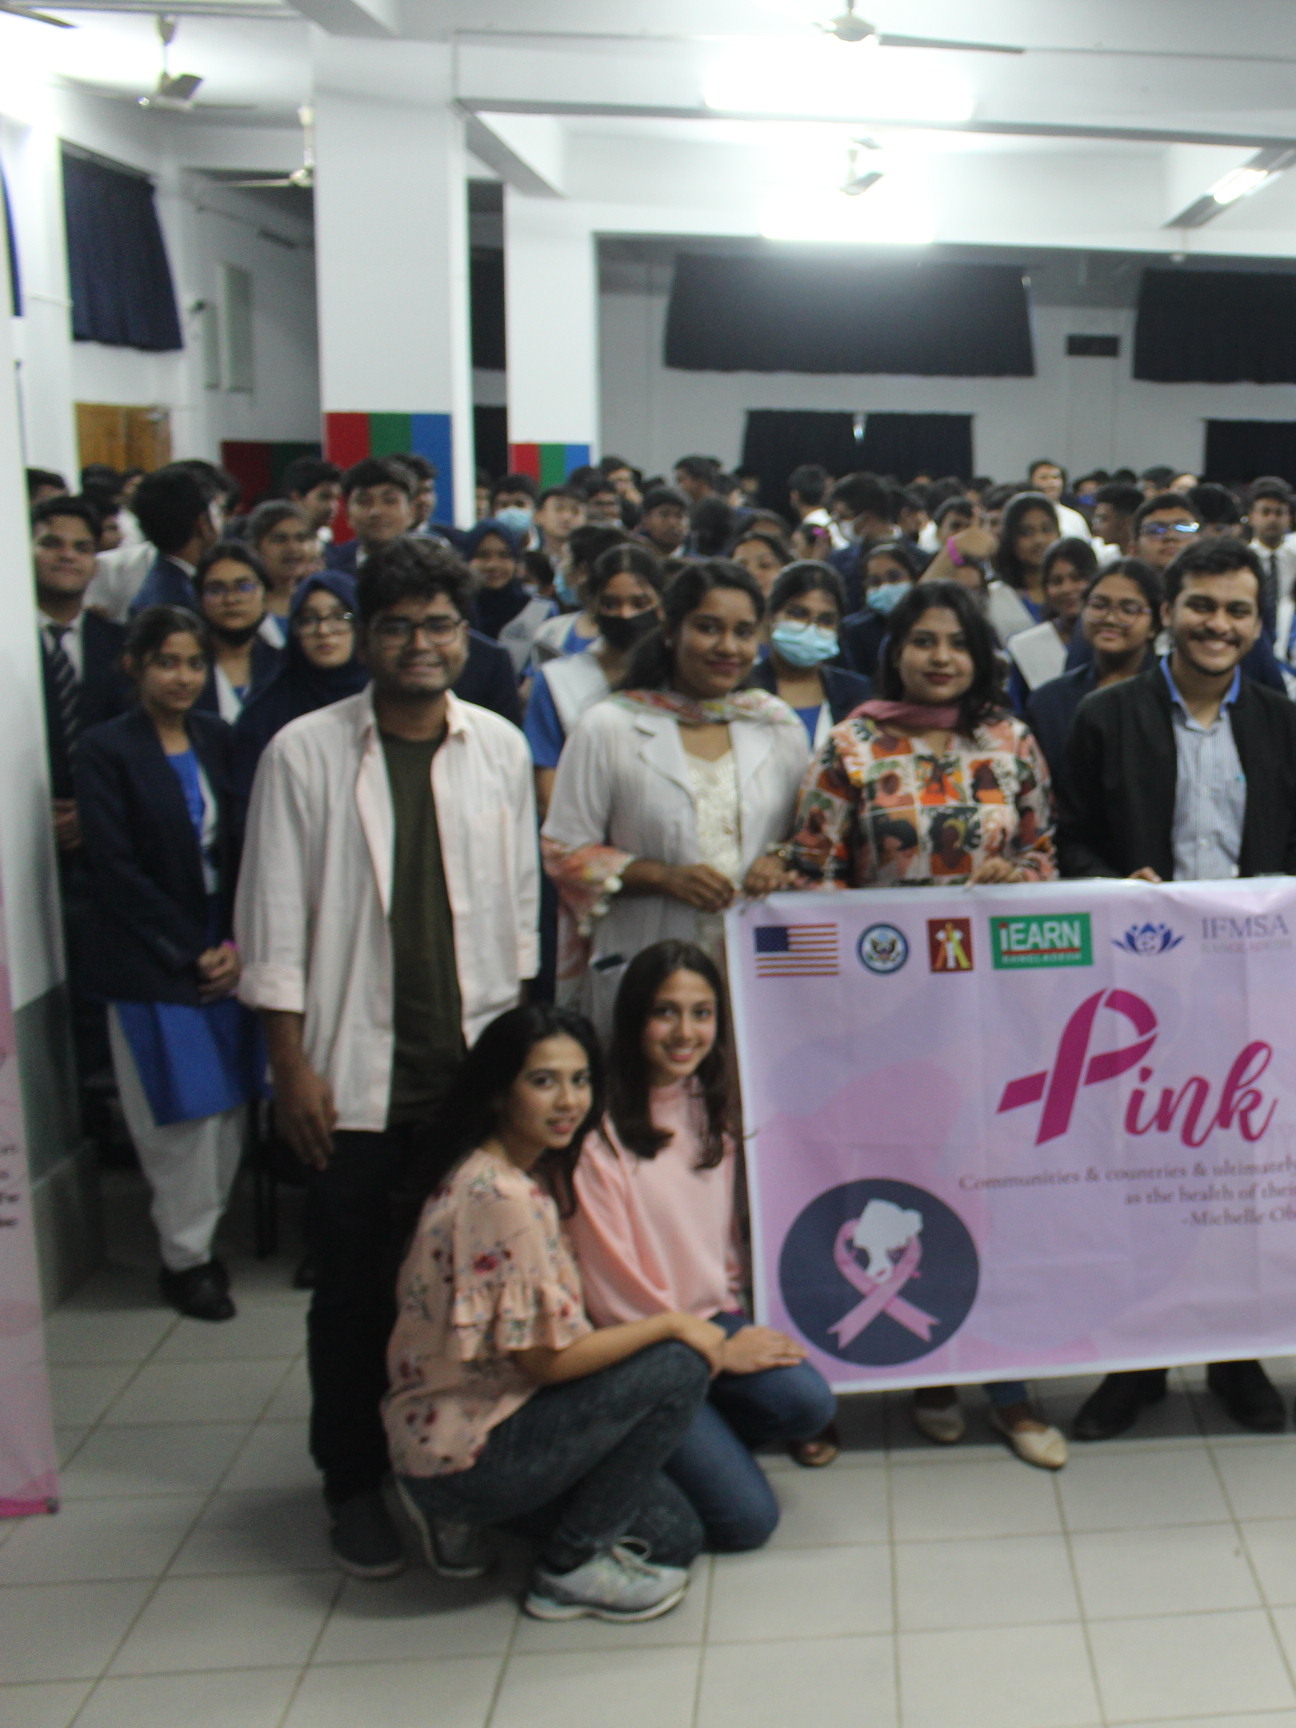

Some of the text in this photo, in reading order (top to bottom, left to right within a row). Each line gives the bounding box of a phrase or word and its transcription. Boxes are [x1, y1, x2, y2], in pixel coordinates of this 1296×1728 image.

[999, 920, 1081, 951] iEARN
[1201, 914, 1289, 940] IFMSA
[997, 988, 1277, 1148] Pink
[959, 1169, 1080, 1191] Communities
[1084, 1165, 1099, 1183] &
[1105, 1162, 1187, 1182] countries
[1192, 1160, 1207, 1177] &
[1124, 1193, 1141, 1205] as
[1146, 1186, 1173, 1204] the
[1178, 1183, 1234, 1204] health
[1238, 1182, 1257, 1200] of
